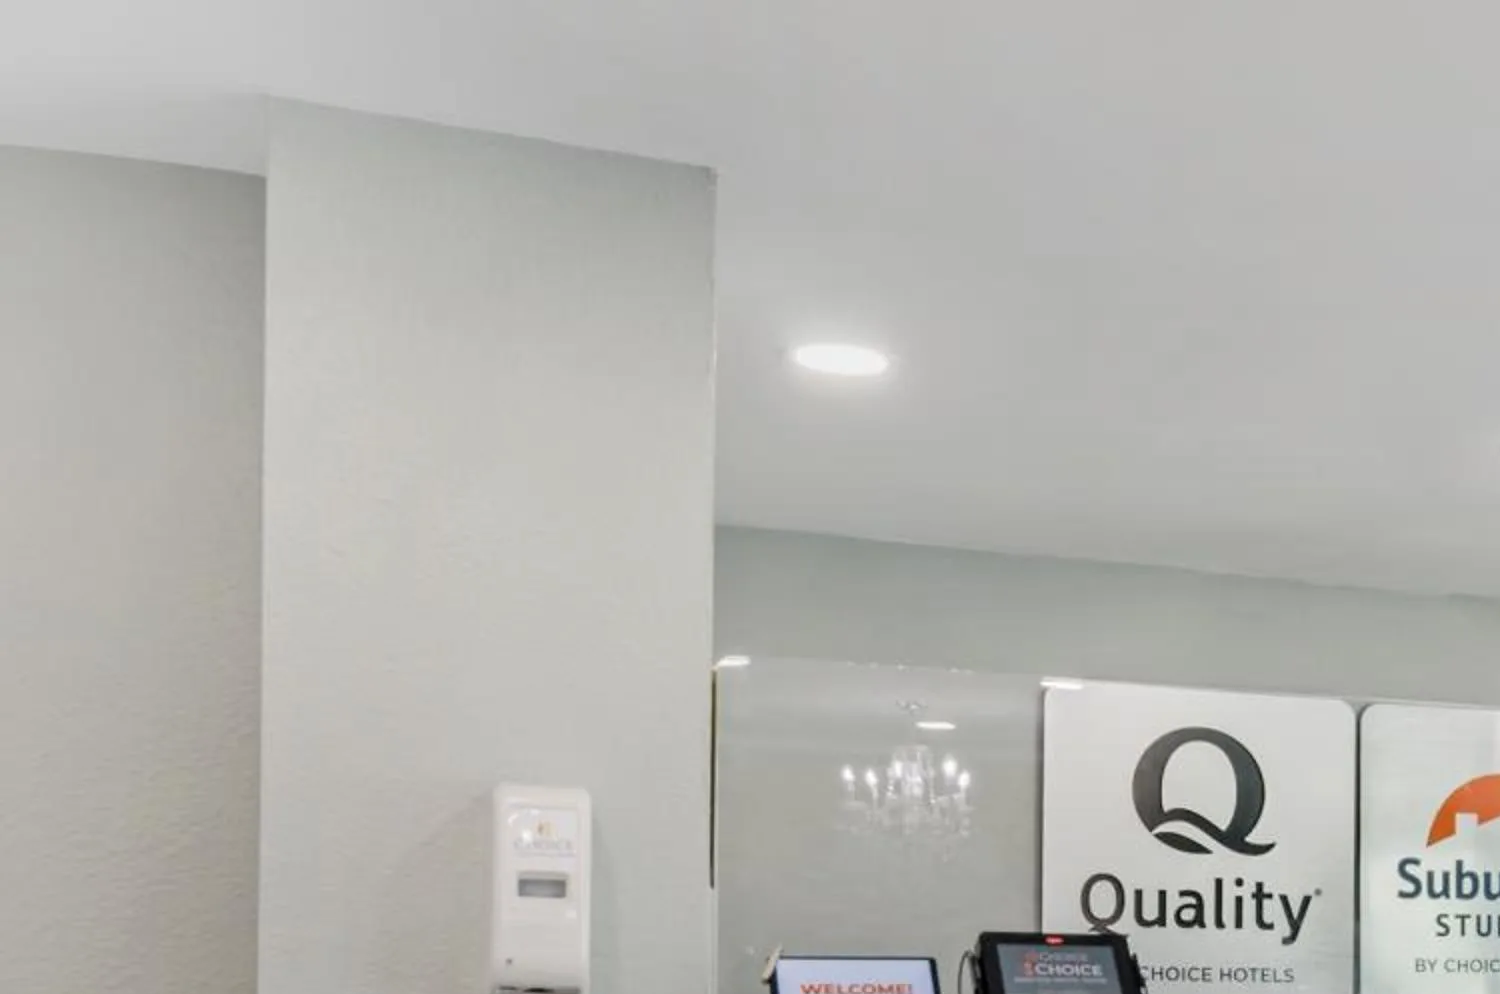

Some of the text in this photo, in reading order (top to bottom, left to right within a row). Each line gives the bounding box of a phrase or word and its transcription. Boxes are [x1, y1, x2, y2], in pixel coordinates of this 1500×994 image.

[1132, 726, 1277, 855] Q
[1080, 873, 1313, 945] Quality
[1035, 962, 1104, 976] CHOICE
[1415, 959, 1437, 973] BY
[1219, 967, 1295, 983] HOTELS
